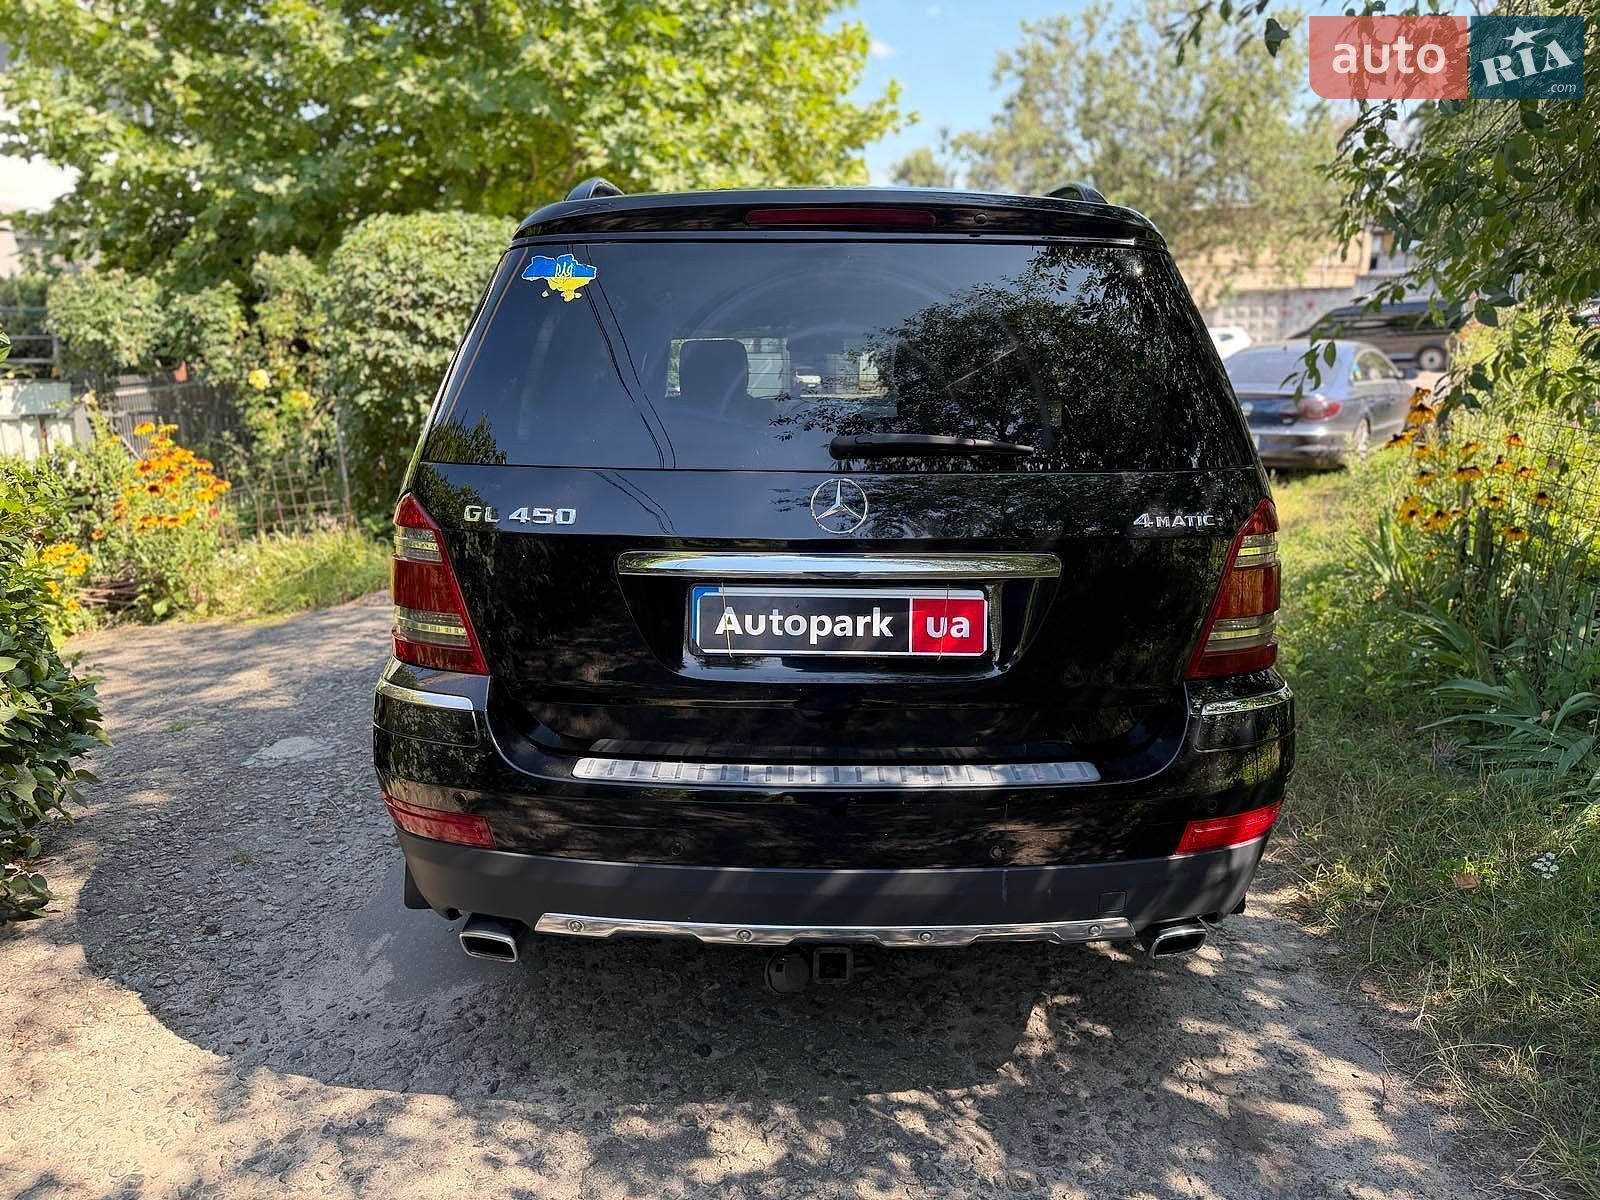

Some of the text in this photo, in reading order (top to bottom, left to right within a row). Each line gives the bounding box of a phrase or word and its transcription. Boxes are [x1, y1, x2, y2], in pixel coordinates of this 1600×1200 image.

[463, 505, 577, 525] GL 450
[714, 606, 970, 645] Autopark ua
